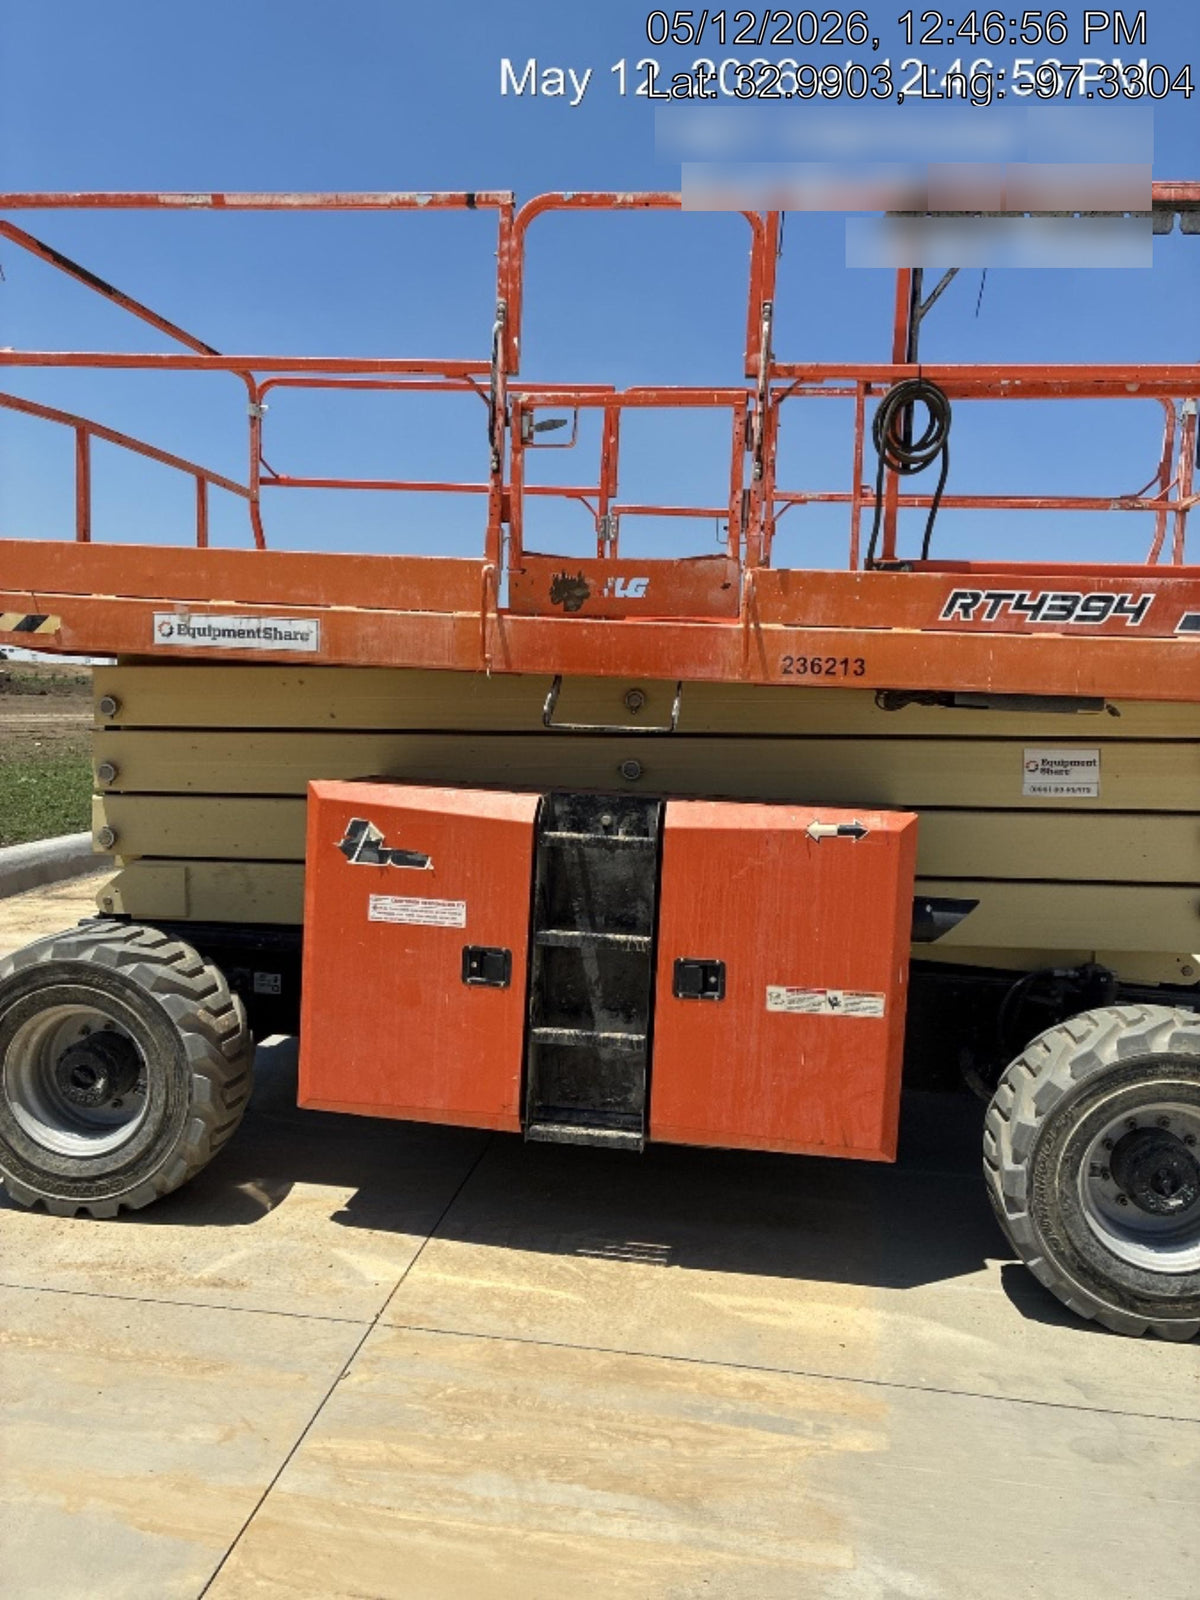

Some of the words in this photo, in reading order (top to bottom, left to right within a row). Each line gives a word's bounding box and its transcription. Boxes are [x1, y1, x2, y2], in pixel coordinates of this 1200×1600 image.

[939, 589, 1156, 626] RT4394
[177, 624, 312, 642] EquipmentShare
[781, 656, 866, 676] 236213
